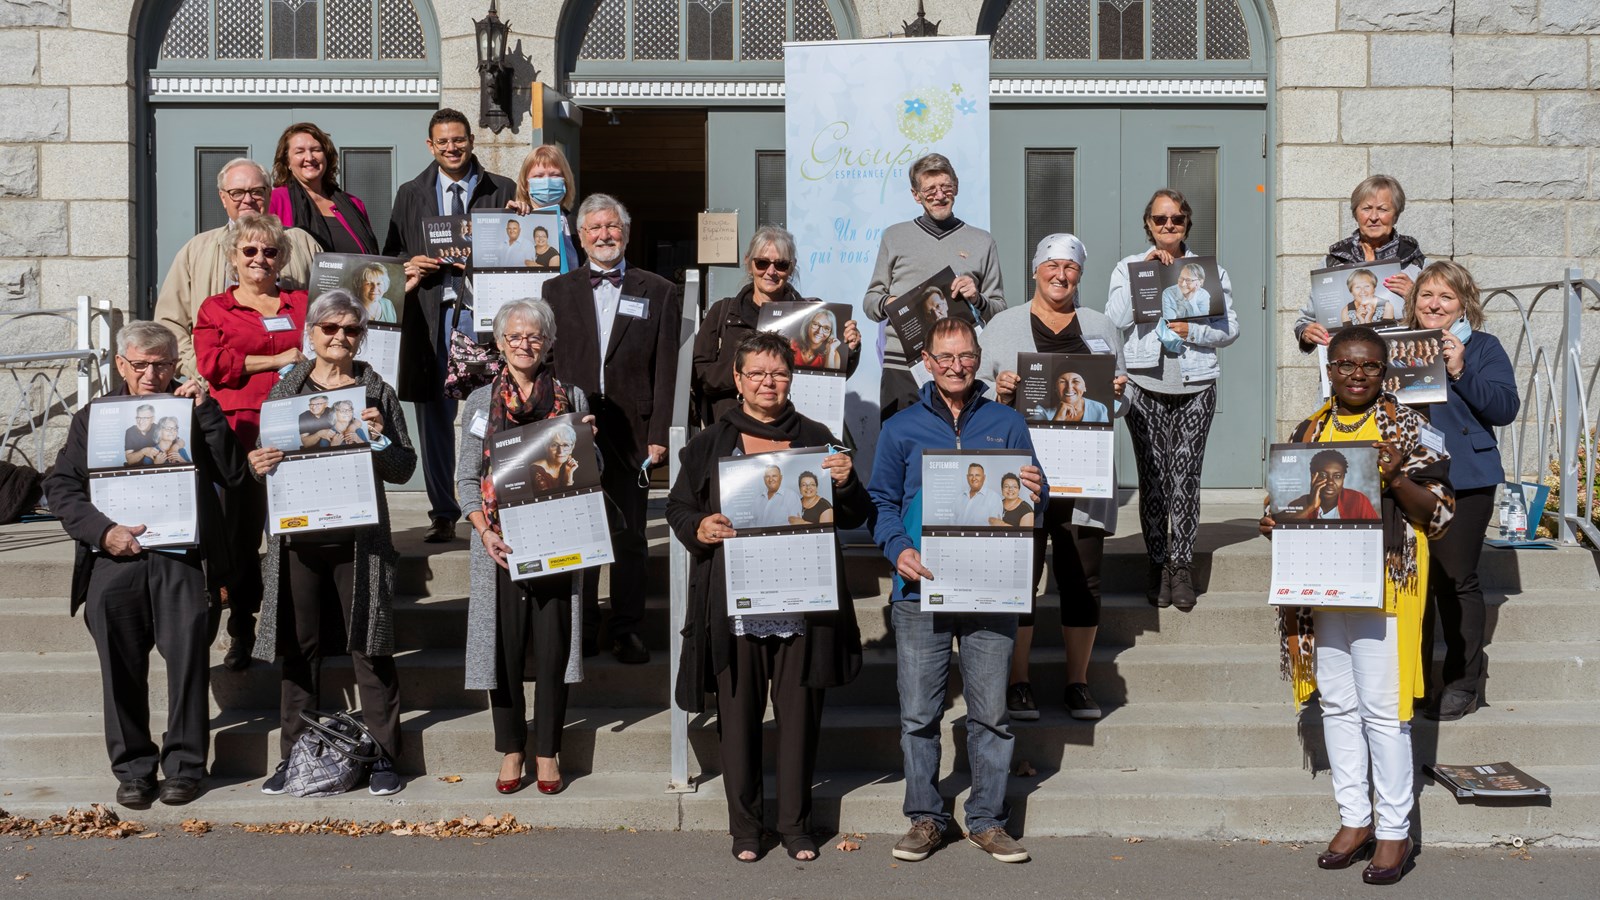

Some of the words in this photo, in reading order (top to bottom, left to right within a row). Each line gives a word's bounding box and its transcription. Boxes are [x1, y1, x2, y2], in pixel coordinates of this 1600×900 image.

[835, 168, 884, 179] ESPÉRANCE
[893, 168, 903, 177] ET
[428, 221, 452, 231] 2022
[834, 216, 857, 241] Un
[429, 230, 452, 238] REGARDS
[810, 246, 832, 272] qui
[840, 250, 870, 263] vous
[318, 260, 343, 270] DÉCEMBRE
[495, 435, 522, 449] NOVEMBRE
[1281, 455, 1297, 463] MARS
[929, 461, 960, 469] SEPTEMBRE
[550, 556, 579, 564] PROMUTUEL
[1301, 588, 1314, 596] IGA
